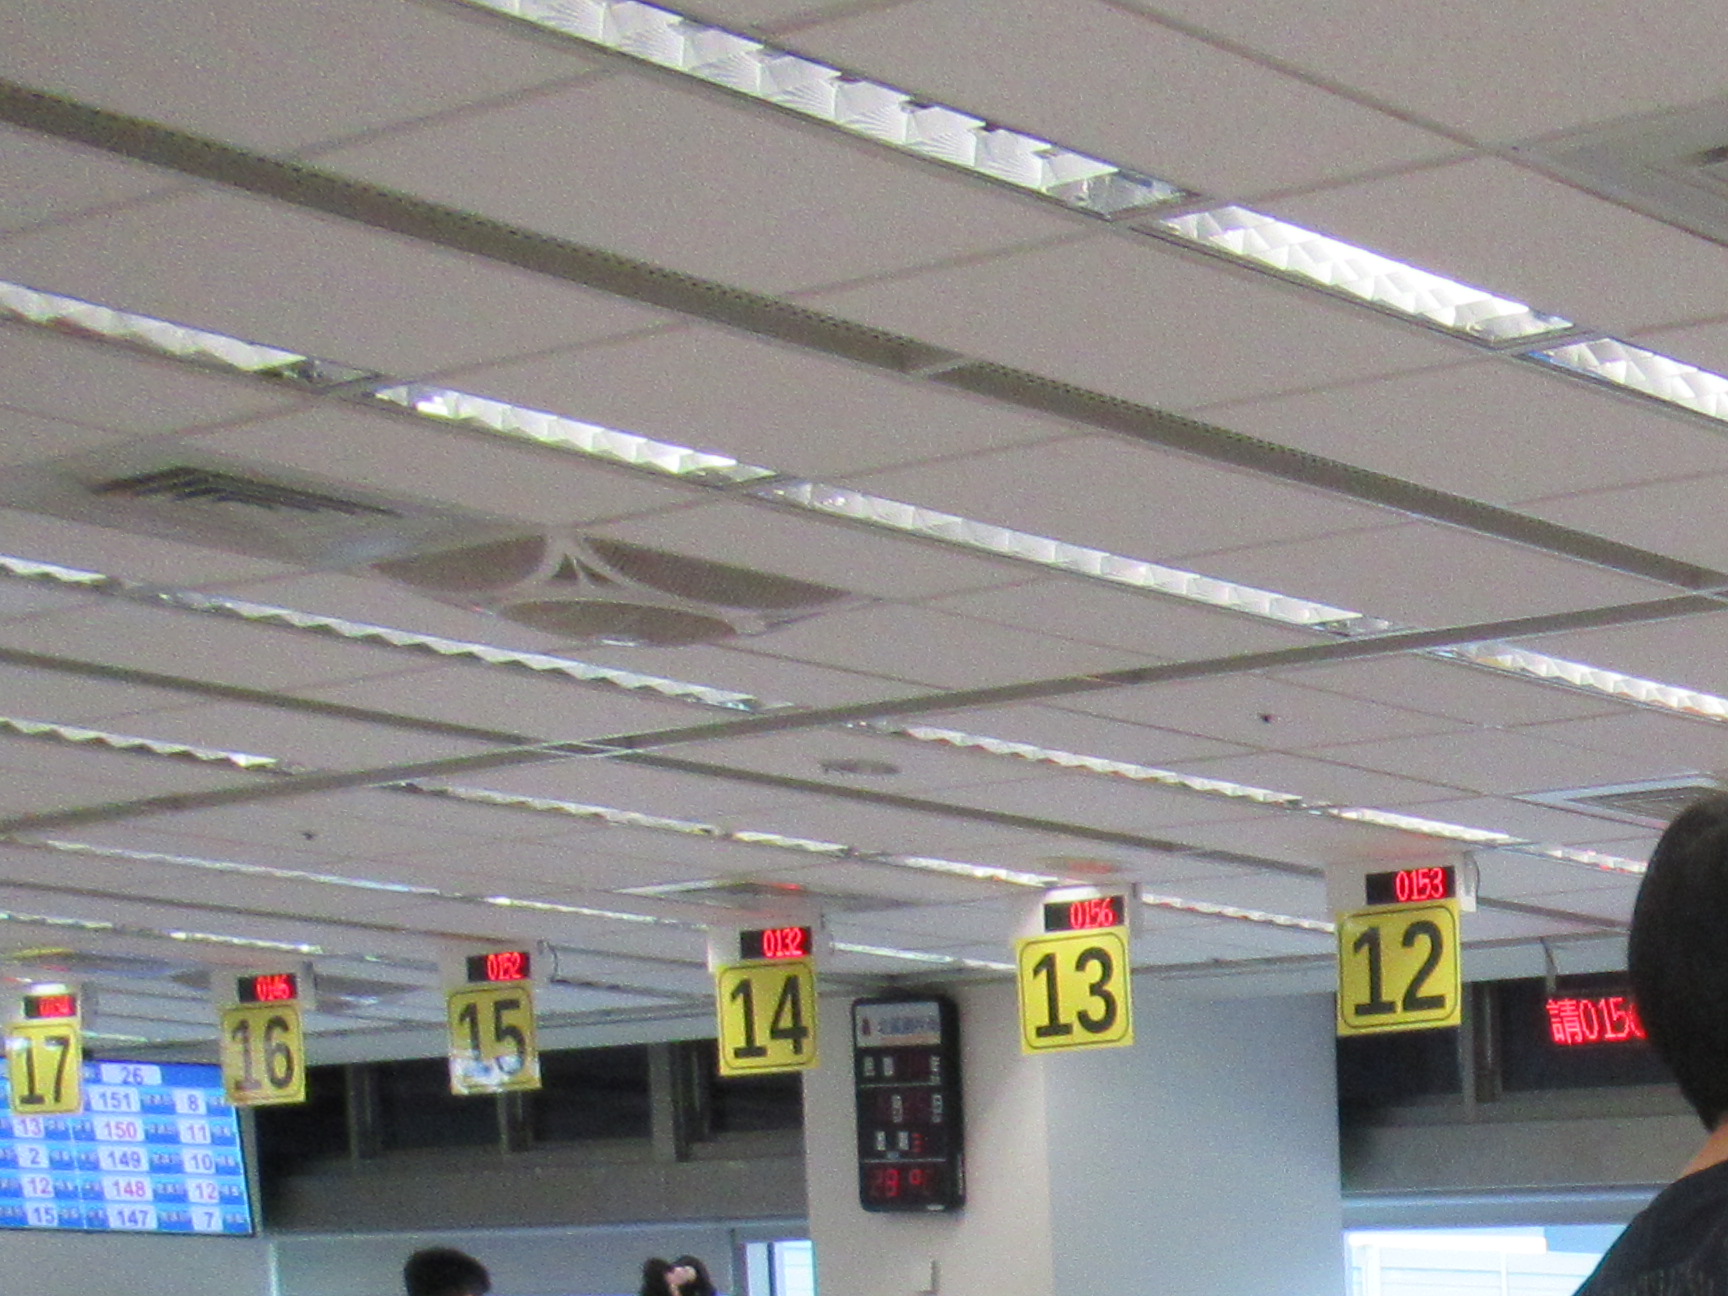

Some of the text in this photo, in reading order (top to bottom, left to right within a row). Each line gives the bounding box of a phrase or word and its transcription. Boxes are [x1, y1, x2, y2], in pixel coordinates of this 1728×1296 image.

[1394, 867, 1444, 901] 0153
[1069, 897, 1114, 930] 0156
[762, 927, 803, 958] 0132
[1351, 920, 1447, 1017] 12
[1032, 946, 1118, 1039] 13
[730, 974, 810, 1059] 14
[231, 1015, 295, 1091] 16
[458, 999, 527, 1077] 15
[18, 1035, 71, 1104] 17
[121, 1066, 144, 1086] 26
[101, 1092, 132, 1110] 151
[104, 1121, 138, 1139] 150
[29, 1147, 41, 1165] 2
[108, 1150, 142, 1169] 149
[191, 1153, 213, 1171] 10
[196, 1182, 218, 1200] 12
[34, 1206, 56, 1225] 15
[118, 1209, 149, 1227] 147
[204, 1211, 214, 1229] 7
